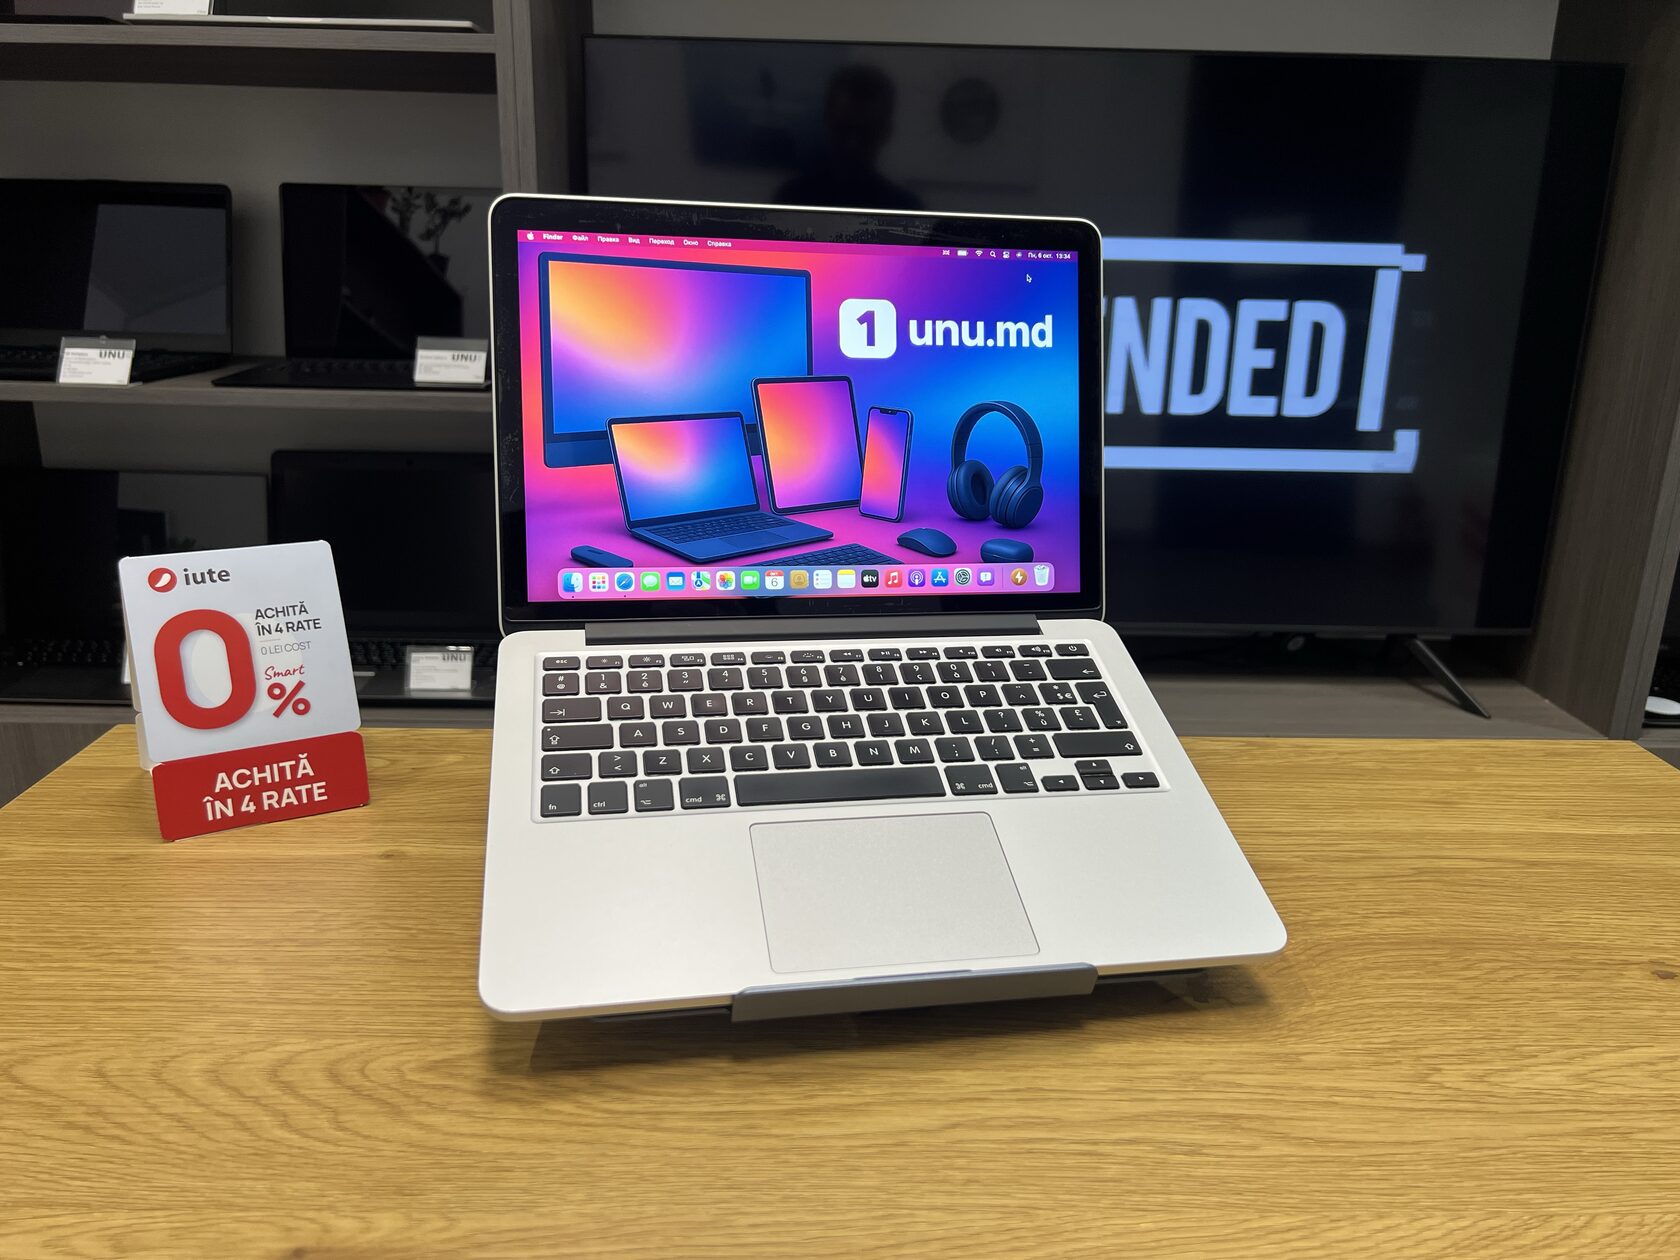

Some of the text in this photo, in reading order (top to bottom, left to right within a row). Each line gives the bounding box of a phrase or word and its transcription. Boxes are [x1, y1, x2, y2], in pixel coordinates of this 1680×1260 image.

[542, 233, 563, 241] Finder
[572, 234, 589, 242] Файл
[597, 236, 620, 244] Правка
[628, 236, 641, 245] Вид
[649, 237, 675, 246] Переход
[683, 239, 699, 247] Окно
[707, 239, 732, 248] Справка
[909, 315, 1053, 348] unu.md
[99, 350, 126, 360] UNU
[452, 353, 477, 362] UNU
[1103, 296, 1346, 417] NDED
[183, 567, 231, 586] iute
[770, 577, 780, 588] 6
[255, 601, 309, 620] ACHITĂ
[255, 618, 322, 636] ÎN 4 RATE
[268, 645, 284, 655] LEI
[284, 641, 312, 654] COST
[800, 667, 807, 675] 6
[838, 666, 844, 674] 7
[875, 665, 883, 673] 8
[913, 664, 920, 672] 9
[949, 663, 957, 671] 0
[264, 664, 305, 681] Smart
[641, 672, 648, 680] 2
[681, 671, 689, 679] 3
[761, 668, 768, 676] 5
[600, 673, 605, 681] 1
[863, 694, 873, 702] U
[940, 691, 950, 699] O
[979, 690, 987, 698] P
[267, 680, 311, 718] %
[706, 699, 713, 708] E
[746, 698, 754, 706] R
[786, 696, 793, 705] T
[825, 695, 833, 703] Y
[620, 702, 631, 711] Q
[662, 701, 674, 709] W
[841, 720, 852, 729] H
[884, 719, 889, 728] J
[921, 718, 930, 726] K
[961, 717, 969, 725] L
[719, 725, 729, 734] D
[762, 723, 769, 732] F
[801, 722, 811, 731] G
[633, 729, 643, 737] A
[677, 727, 685, 736] S
[829, 749, 838, 758] B
[869, 747, 879, 756] N
[909, 745, 921, 754] M
[702, 754, 712, 763] X
[745, 752, 754, 761] C
[786, 750, 795, 759] V
[659, 756, 668, 765] Z
[214, 753, 315, 793] ACHITĂ
[203, 781, 329, 822] ÎN 4 RATE
